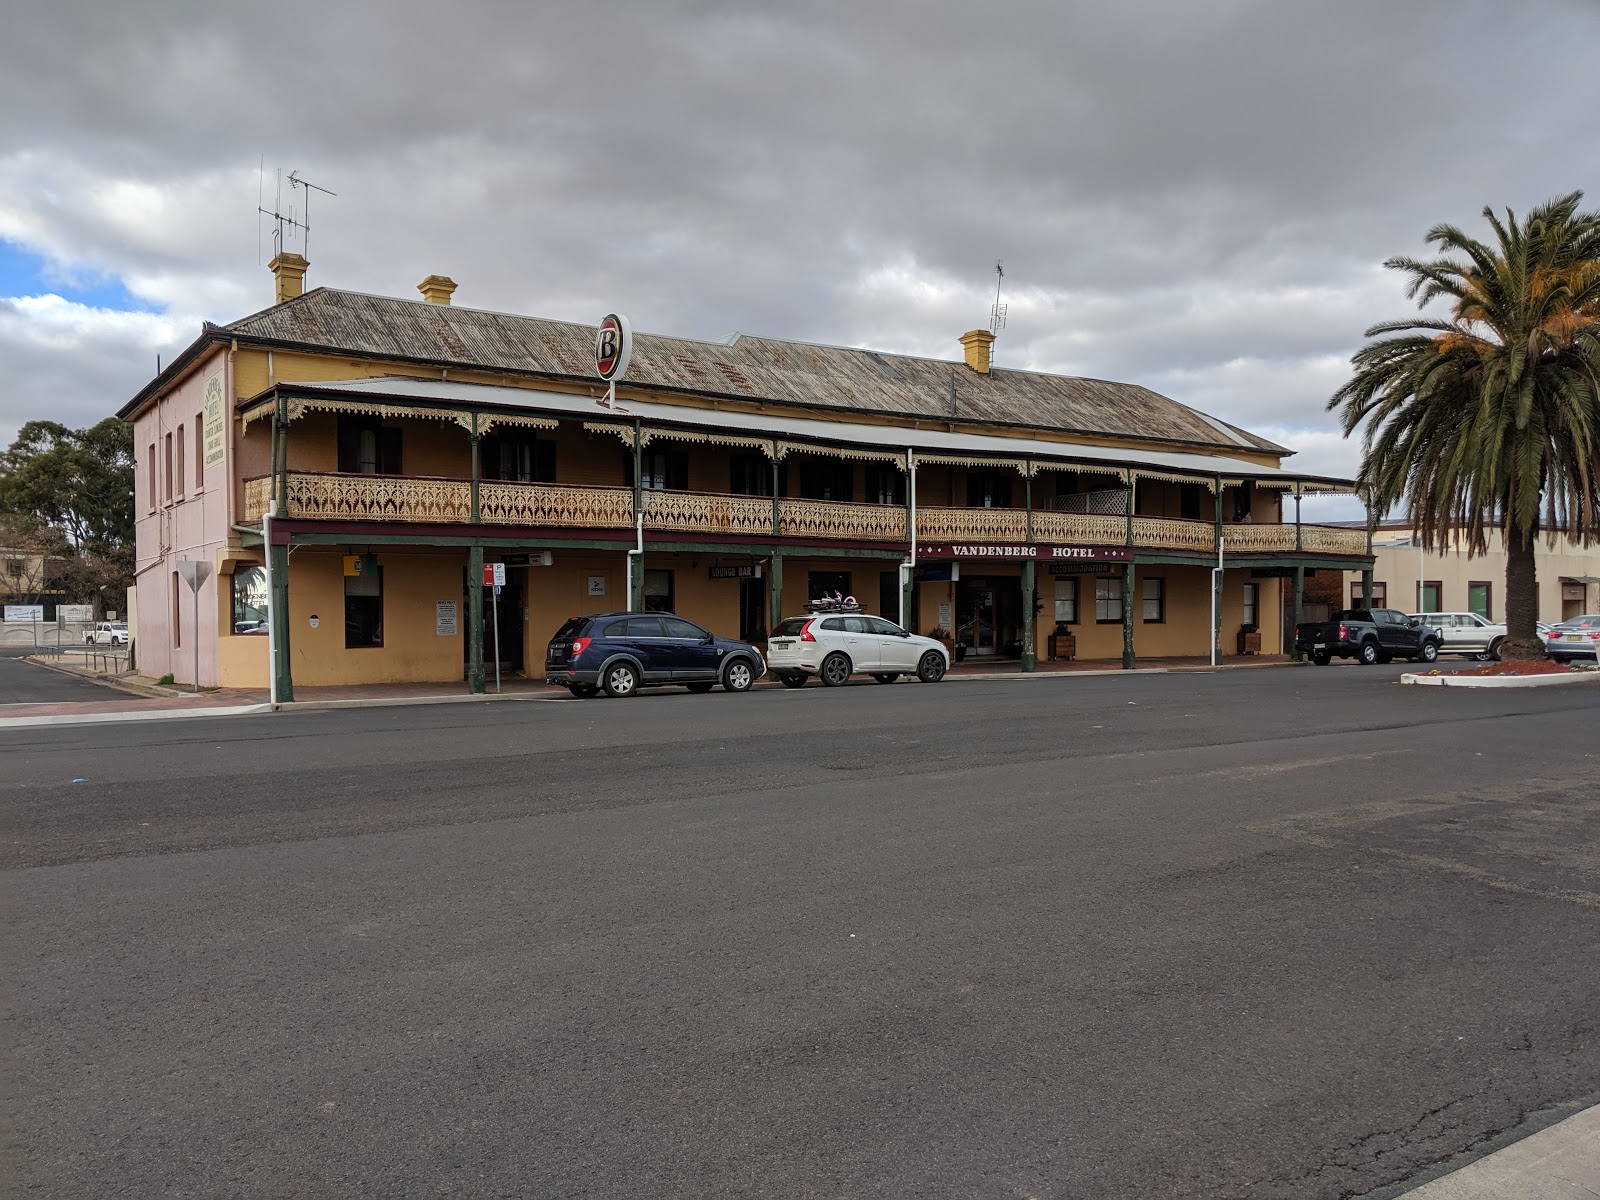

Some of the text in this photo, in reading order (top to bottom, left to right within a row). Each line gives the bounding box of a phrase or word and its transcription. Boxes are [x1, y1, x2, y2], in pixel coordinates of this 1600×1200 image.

[951, 545, 1095, 558] VANDENBERG HOTEL
[711, 566, 752, 577] LOUNGE BAR
[1050, 564, 1109, 574] ACCOMMODATION
